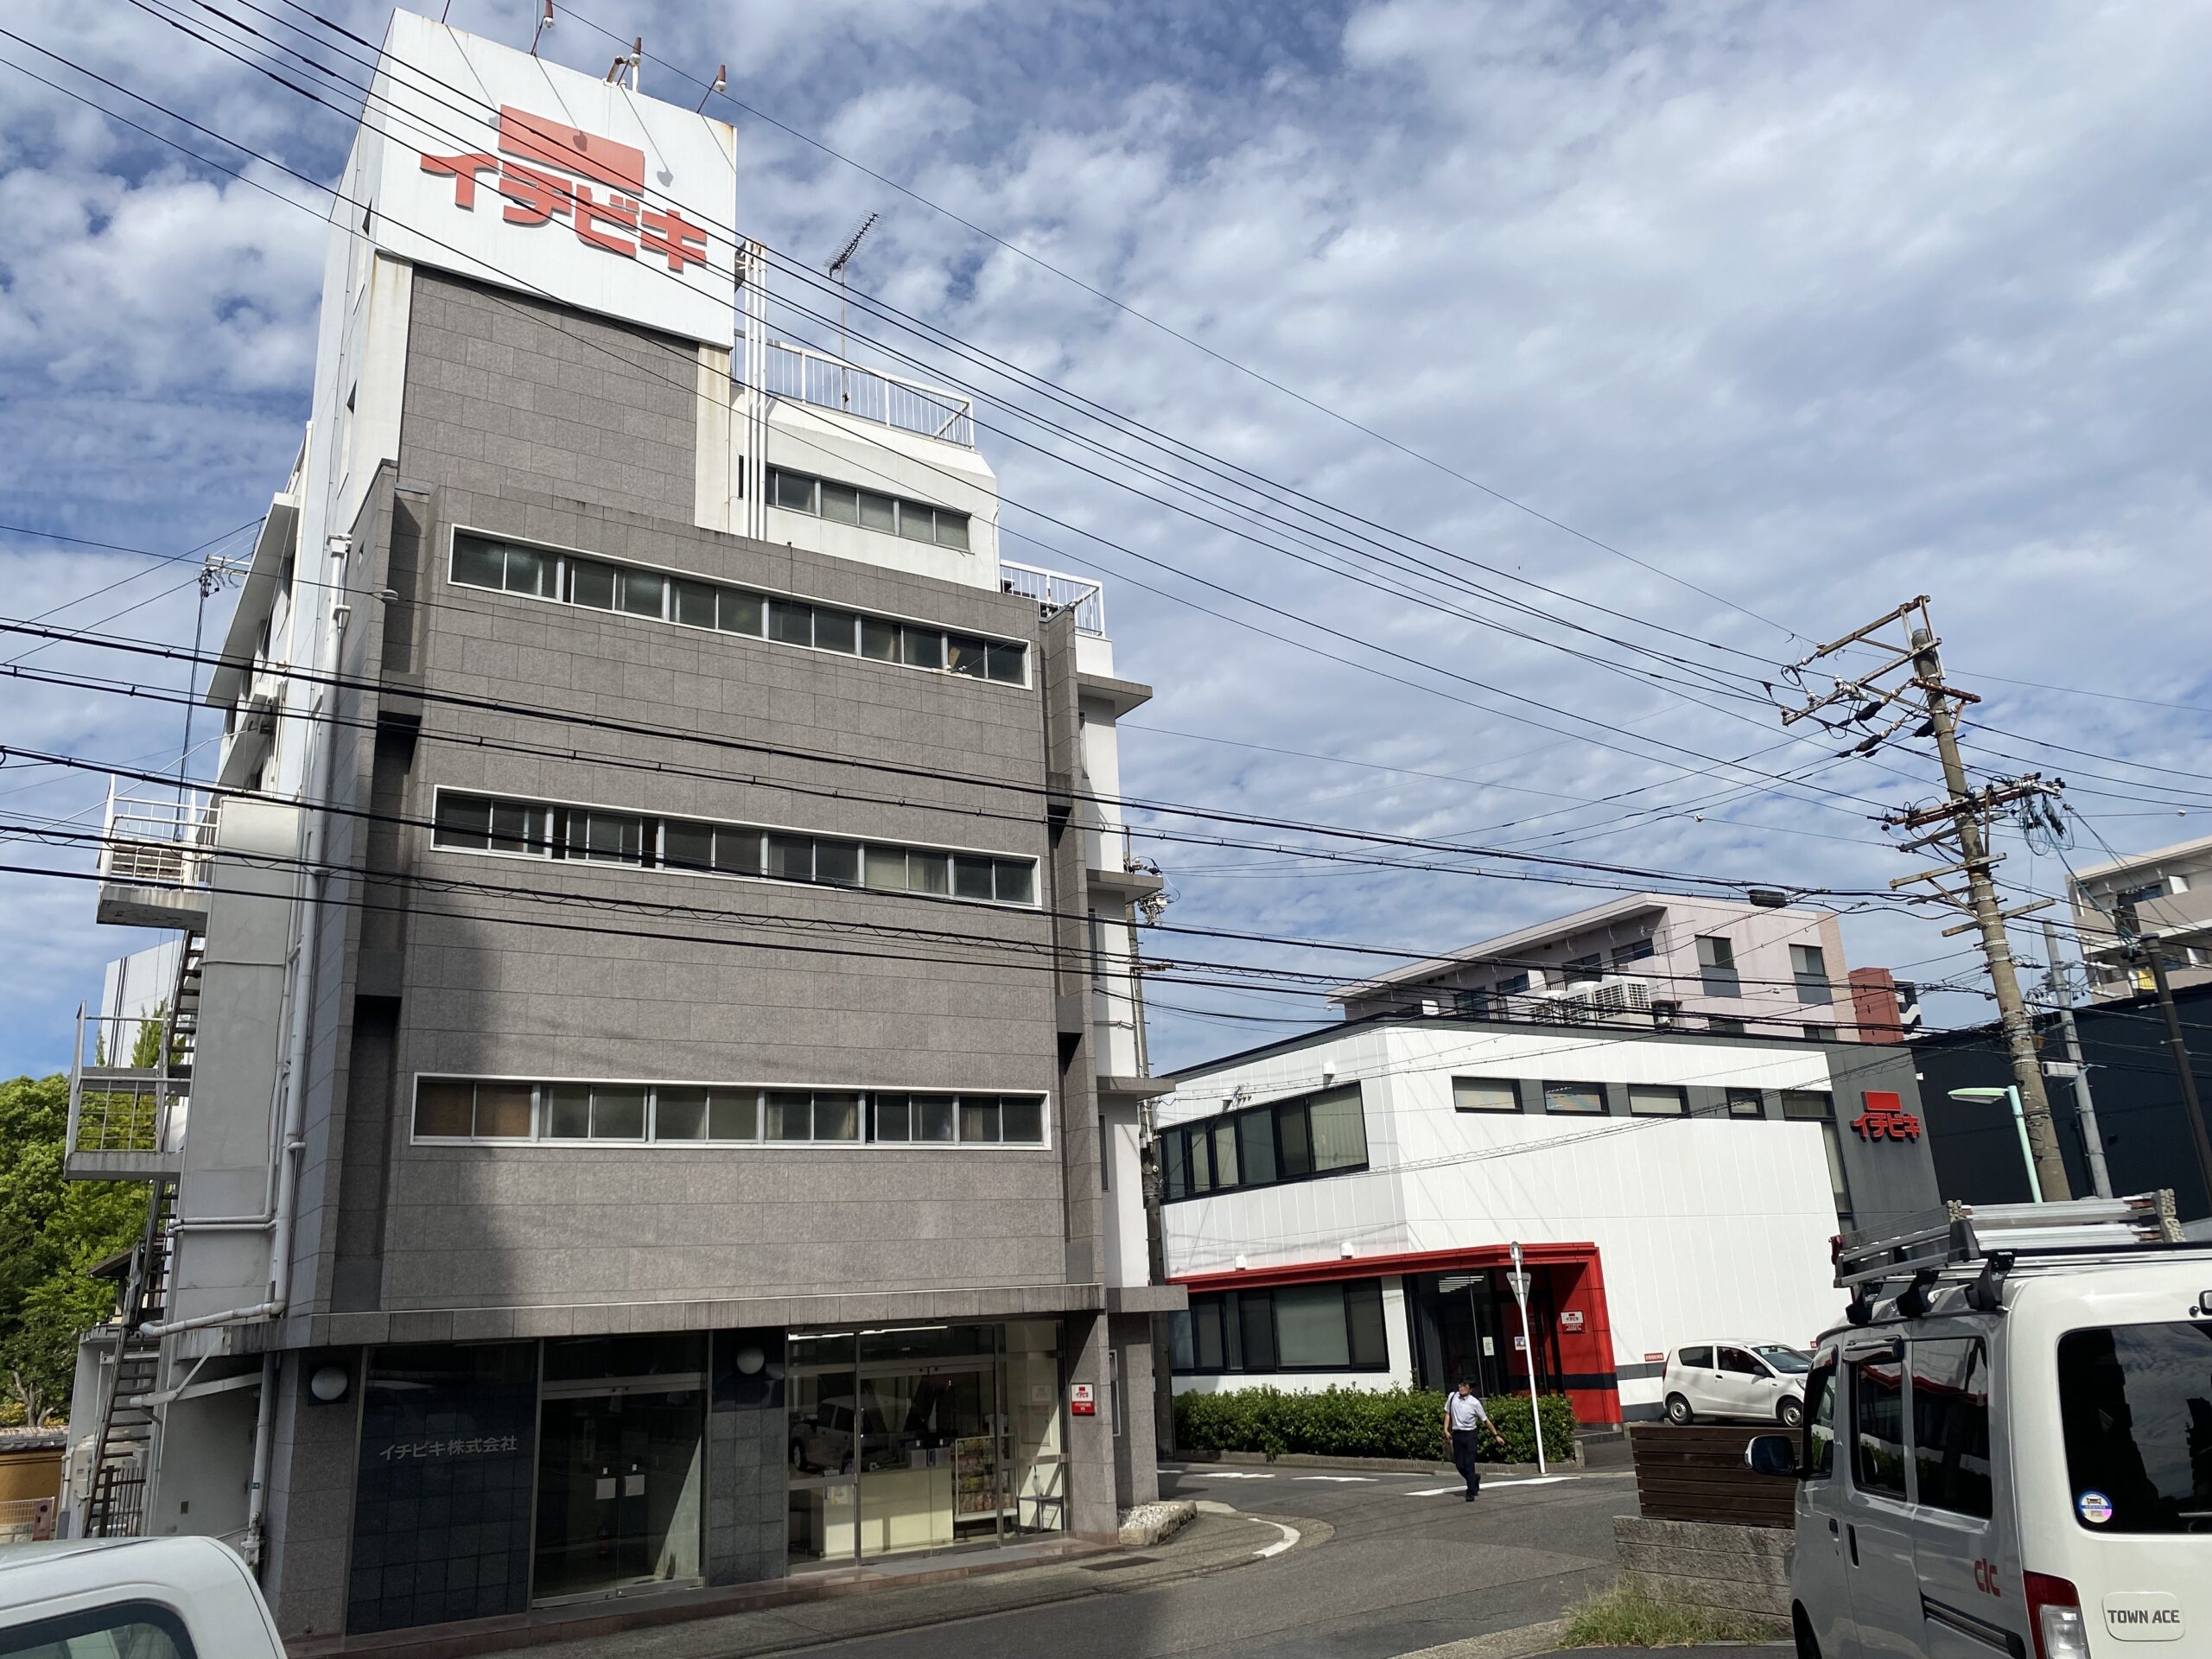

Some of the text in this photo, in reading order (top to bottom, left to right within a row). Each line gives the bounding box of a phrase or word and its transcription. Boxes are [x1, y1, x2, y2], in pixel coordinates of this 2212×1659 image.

[420, 153, 708, 273] イチビキ
[1852, 1112, 1922, 1139] イチビキ
[379, 1434, 518, 1460] イチビキ株式会社
[2107, 1610, 2180, 1624] TOWN ACE
